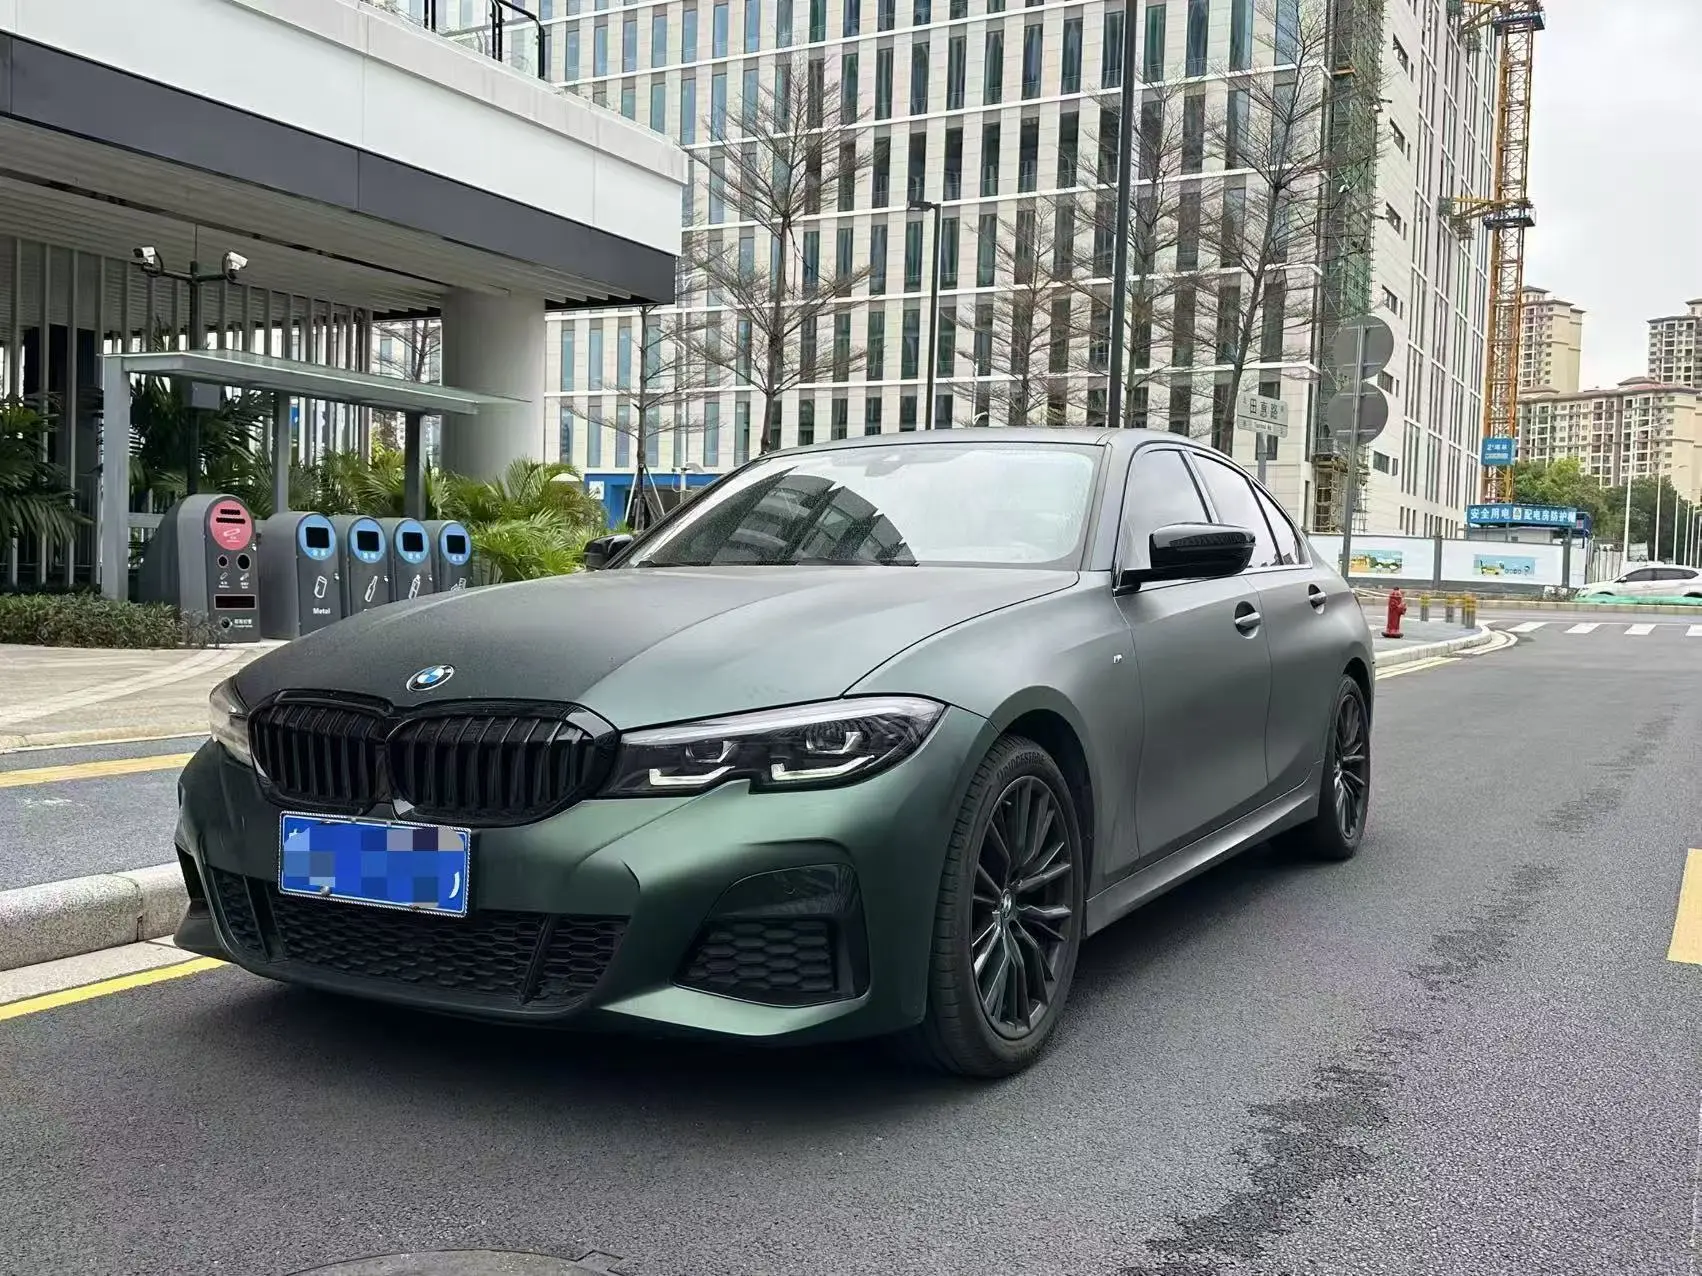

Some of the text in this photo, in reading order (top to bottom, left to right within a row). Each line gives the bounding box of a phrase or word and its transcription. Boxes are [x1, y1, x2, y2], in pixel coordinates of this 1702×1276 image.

[1470, 507, 1510, 520] 安全用电
[312, 607, 331, 615] Metal
